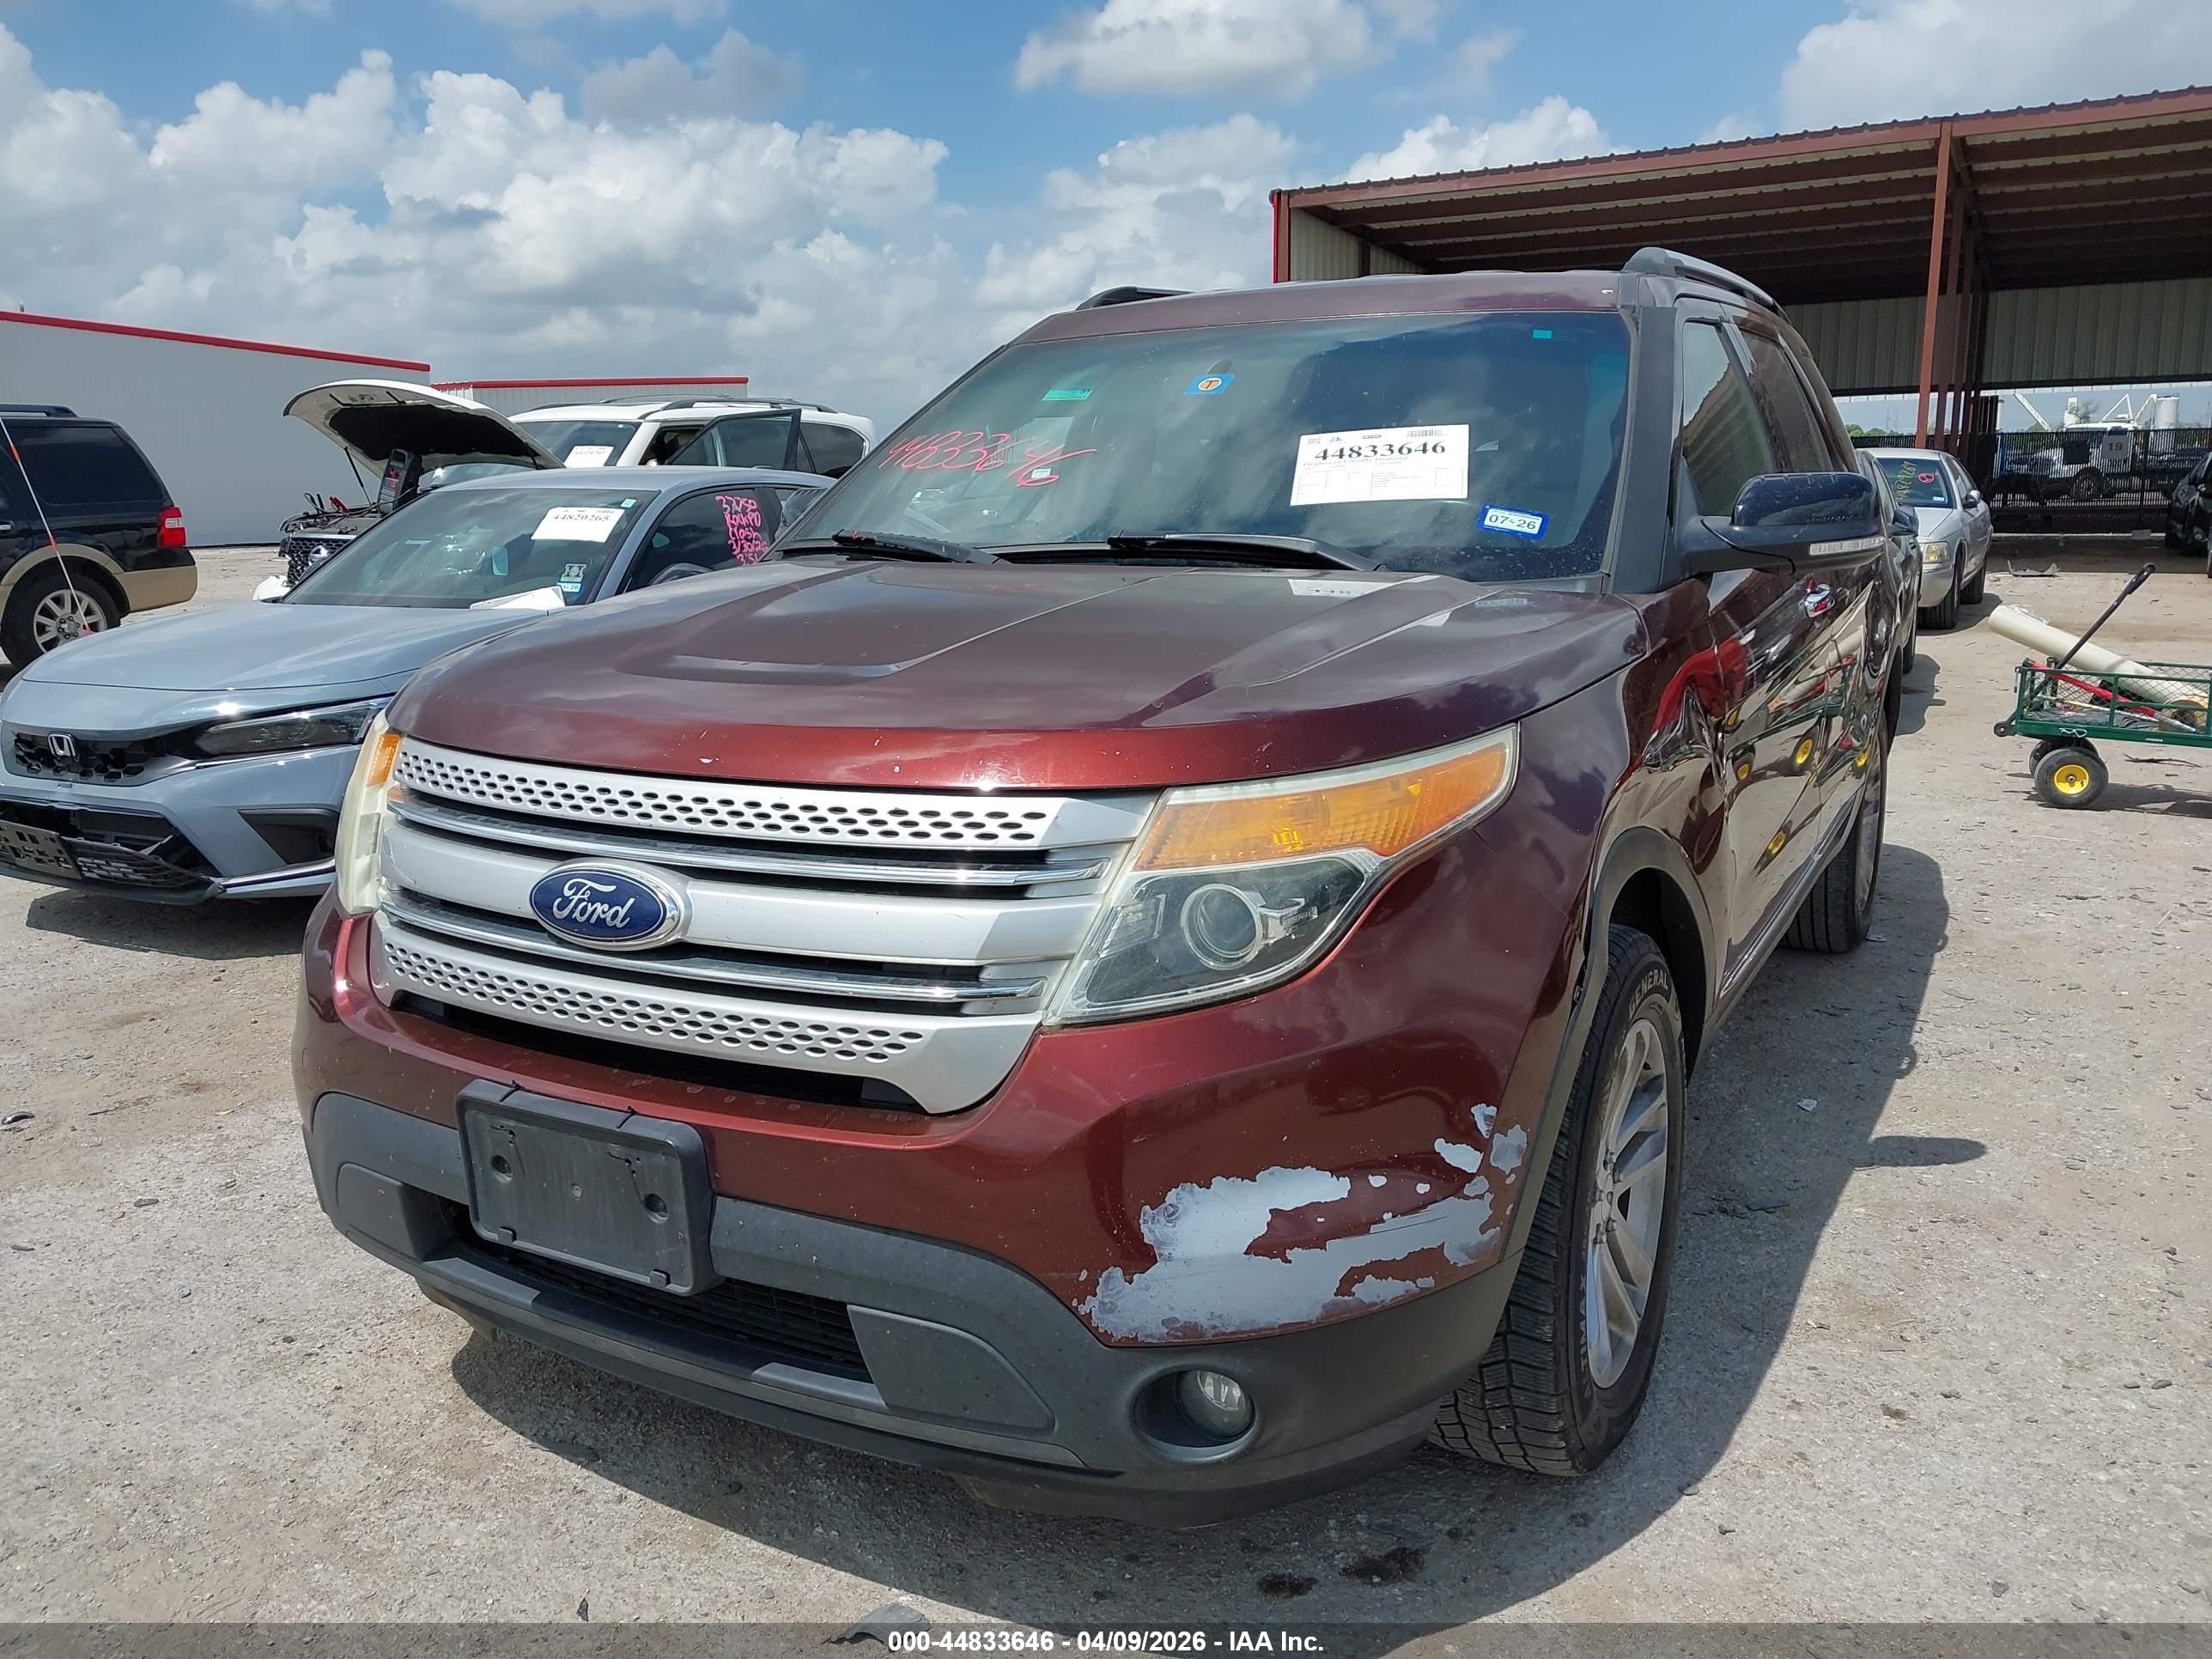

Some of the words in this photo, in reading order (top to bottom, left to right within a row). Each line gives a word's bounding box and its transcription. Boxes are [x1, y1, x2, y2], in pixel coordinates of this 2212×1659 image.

[1315, 440, 1447, 460] 44833646
[2108, 441, 2124, 451] 19
[1488, 514, 1537, 530] 07-26
[552, 878, 635, 928] Ford
[1629, 969, 1668, 1021] GENERAL
